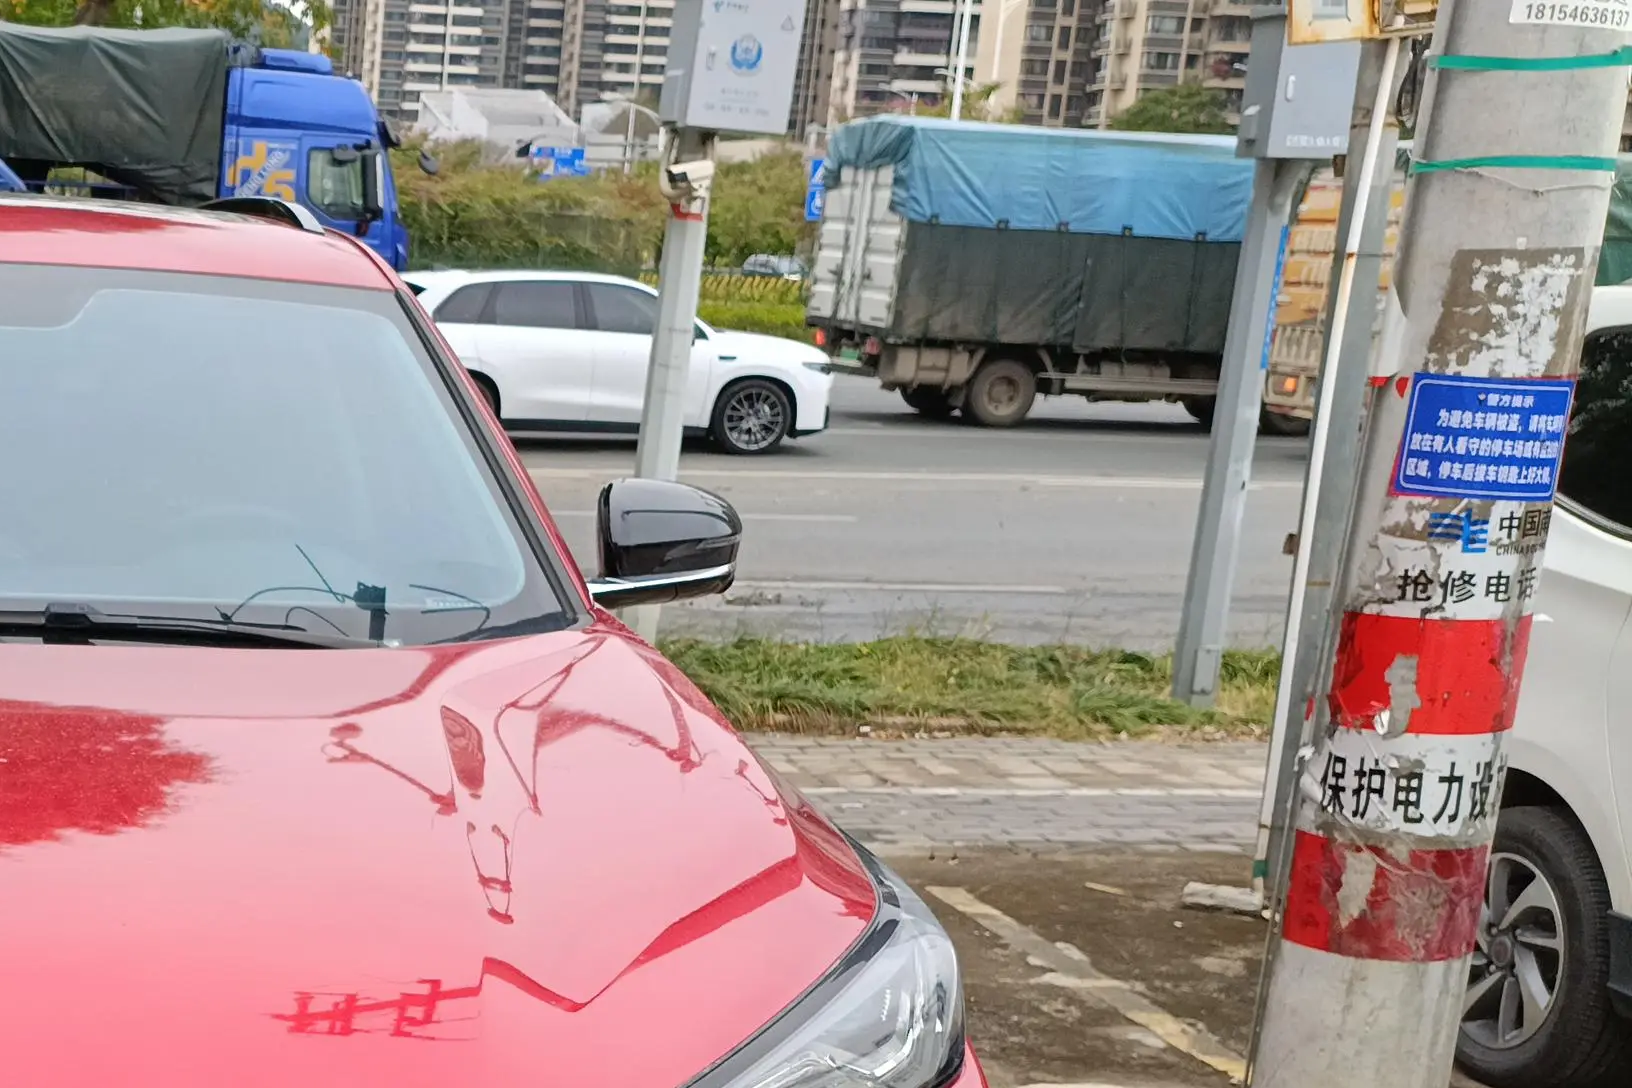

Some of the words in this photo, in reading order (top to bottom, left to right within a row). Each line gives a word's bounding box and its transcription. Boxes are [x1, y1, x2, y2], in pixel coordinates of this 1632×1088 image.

[1525, 3, 1630, 28] 18154636137
[1487, 393, 1535, 408] 警方提示
[1397, 567, 1537, 604] 抢修电话
